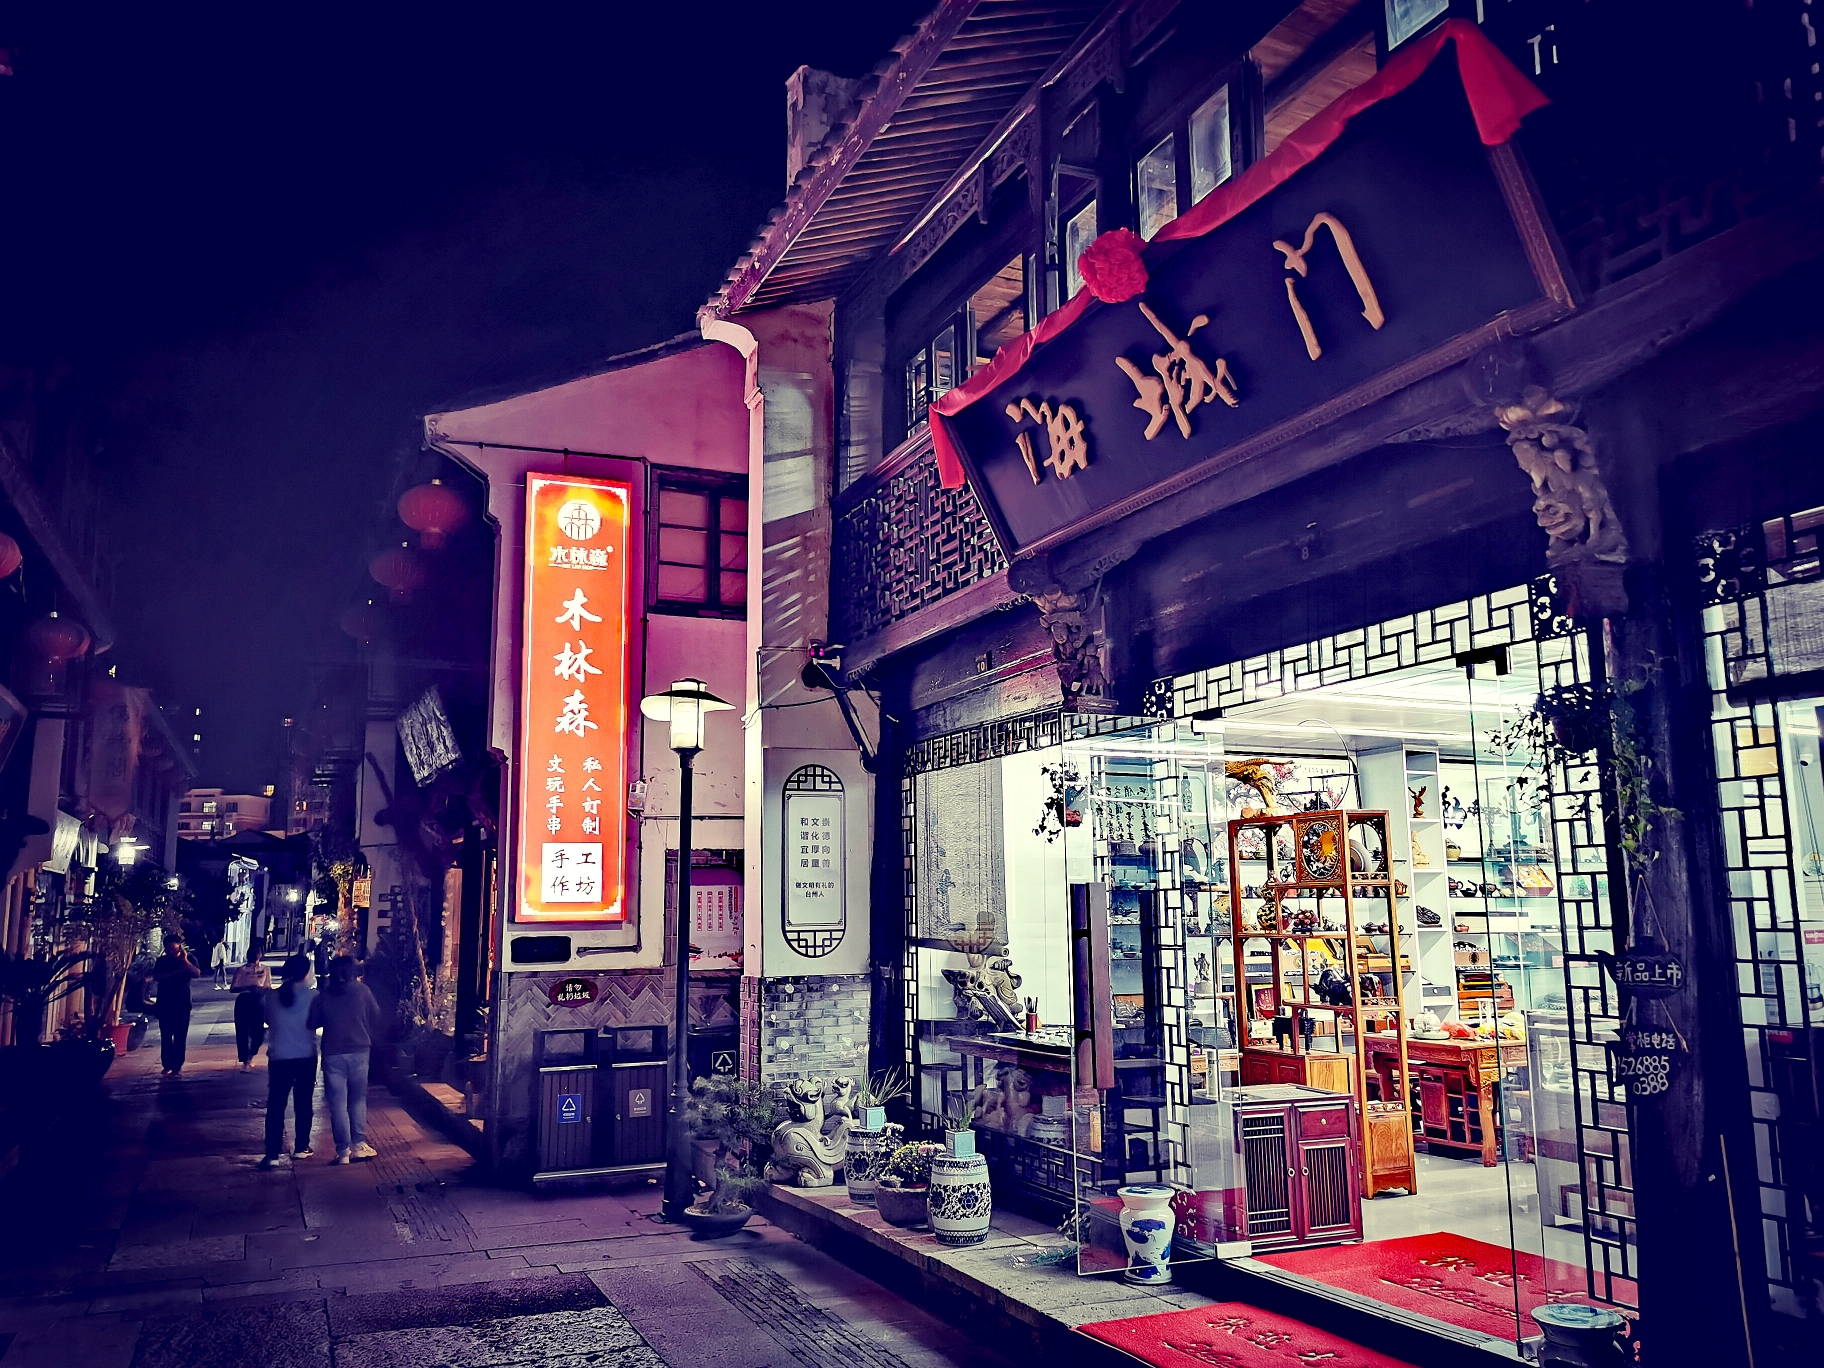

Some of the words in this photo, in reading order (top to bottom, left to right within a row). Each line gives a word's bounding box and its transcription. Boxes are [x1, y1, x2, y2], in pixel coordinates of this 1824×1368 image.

[552, 587, 603, 738] 木林森
[545, 753, 566, 835] 文玩手串
[581, 756, 602, 835] 私人订制
[800, 817, 809, 868] 和谐宜居
[551, 849, 596, 868] 手工
[550, 875, 596, 896] 作坊
[805, 890, 825, 898] 台州人
[1615, 961, 1682, 986] 新品上市
[557, 991, 591, 1002] 乱扔垃圾
[565, 983, 583, 992] 请勿
[1626, 1031, 1676, 1053] 掌柜电话
[1617, 1055, 1670, 1076] 1526885
[1633, 1072, 1669, 1095] 0388
